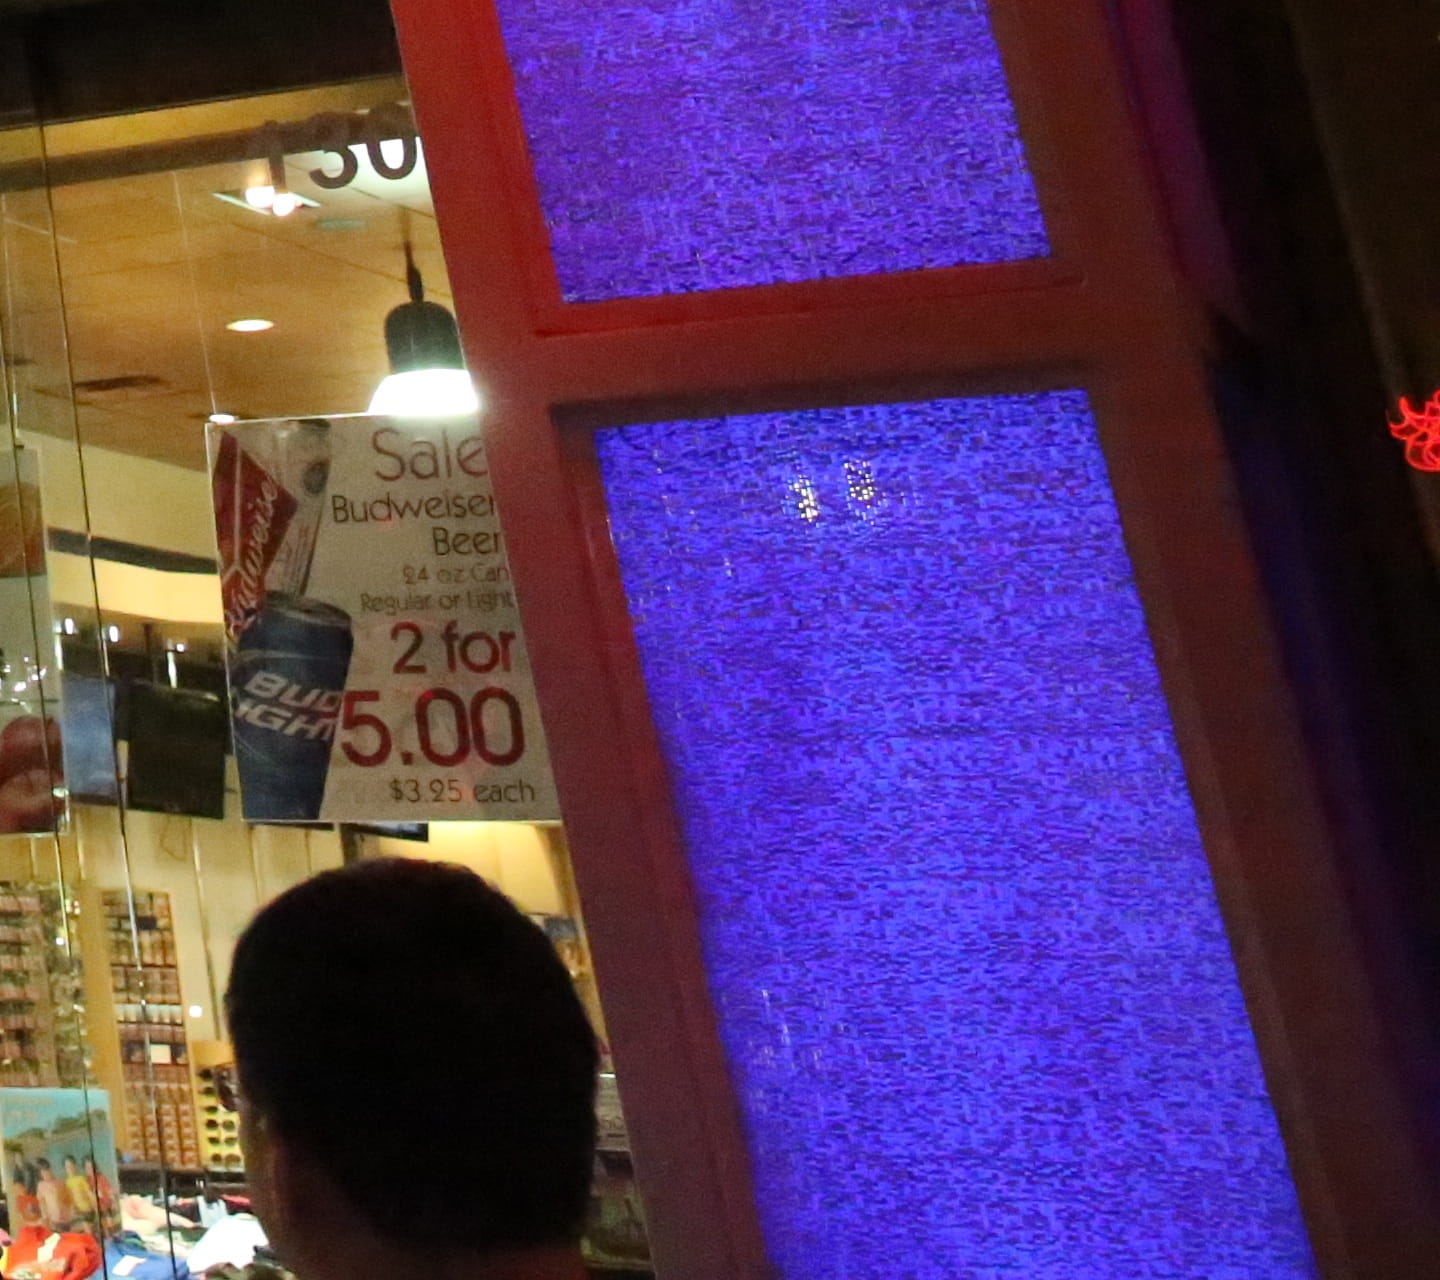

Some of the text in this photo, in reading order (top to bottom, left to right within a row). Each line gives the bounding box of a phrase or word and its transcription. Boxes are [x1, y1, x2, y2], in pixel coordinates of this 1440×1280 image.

[370, 426, 488, 482] Sale
[359, 590, 431, 617] Regular
[389, 619, 518, 675] 2 for
[243, 669, 345, 714] BUD
[340, 686, 526, 768] 5.00
[473, 779, 535, 803] each
